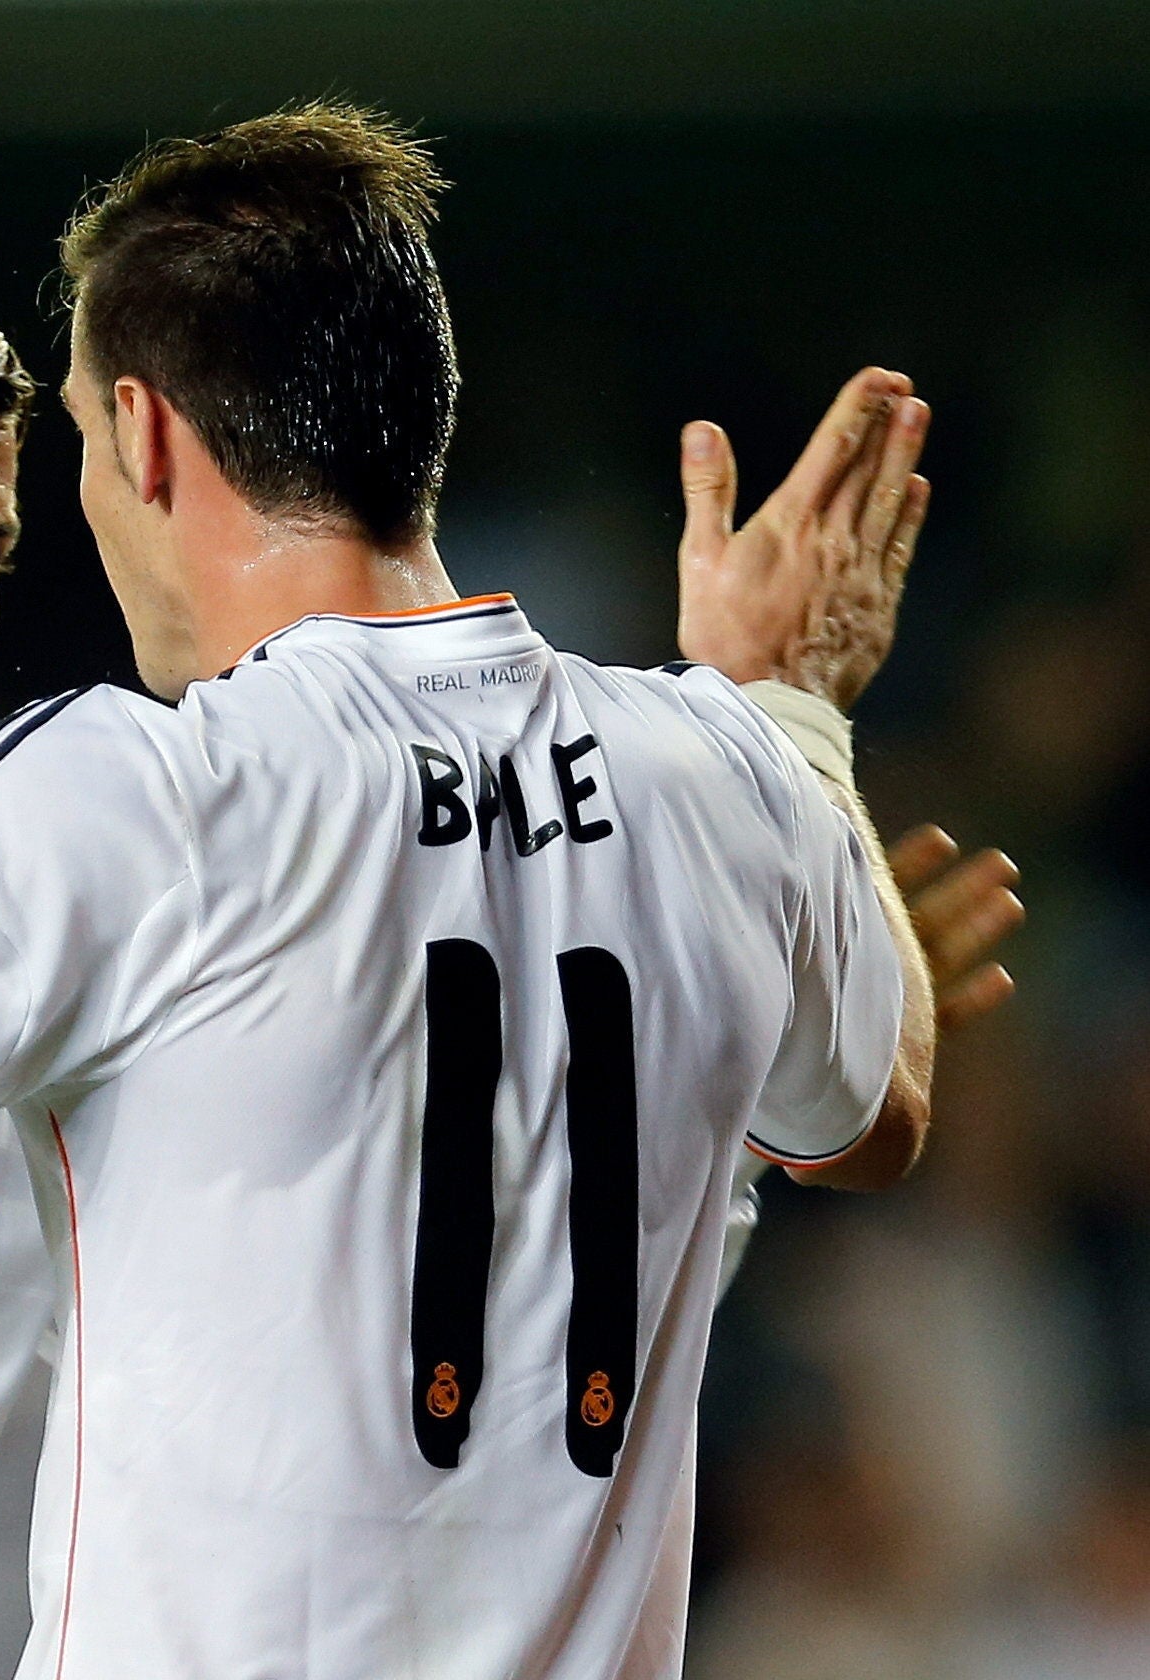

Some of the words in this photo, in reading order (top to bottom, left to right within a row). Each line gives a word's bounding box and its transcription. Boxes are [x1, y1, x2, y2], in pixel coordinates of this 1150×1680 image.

[416, 671, 470, 692] REAL
[410, 734, 614, 857] BALE
[411, 937, 640, 1478] 11
